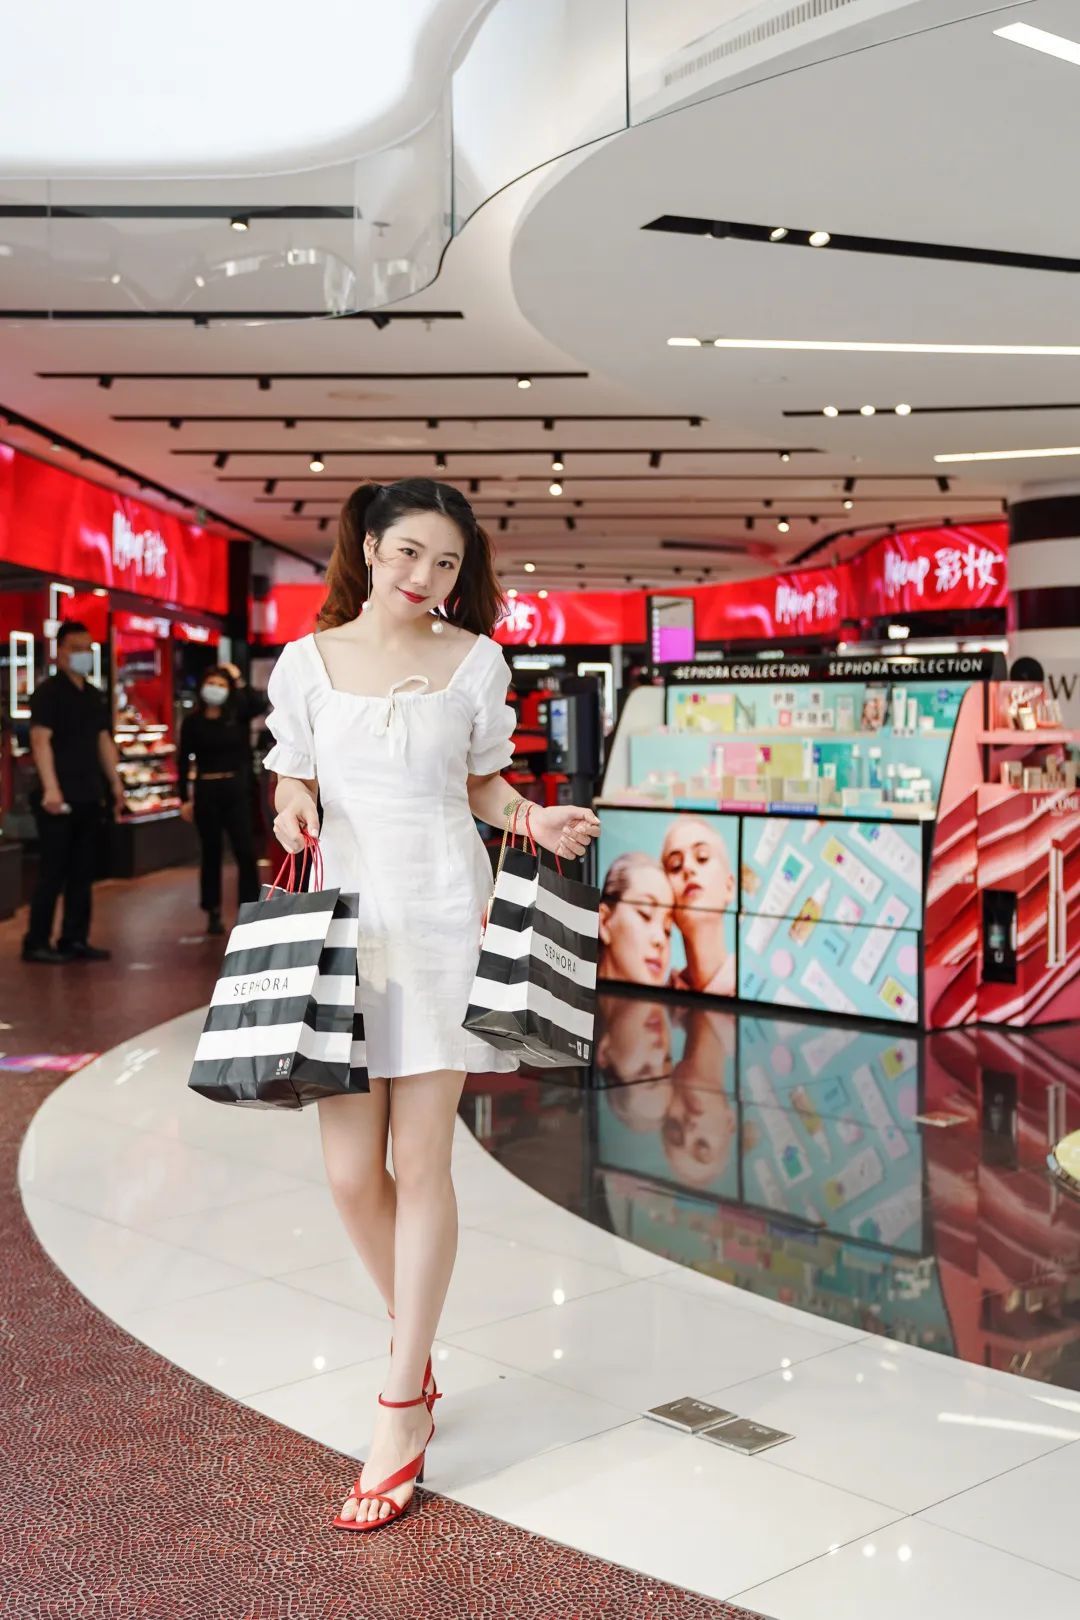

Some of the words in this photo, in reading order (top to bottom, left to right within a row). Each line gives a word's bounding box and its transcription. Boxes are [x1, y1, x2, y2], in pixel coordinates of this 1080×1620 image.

[934, 543, 1003, 593] 彩妆
[676, 665, 730, 679] SEPHORA
[731, 663, 810, 679] COLLECTION
[829, 662, 888, 676] SEPHORA
[892, 658, 983, 674] COLLECTION
[544, 943, 576, 974] SEPHORA
[233, 977, 289, 997] SEPHORA
